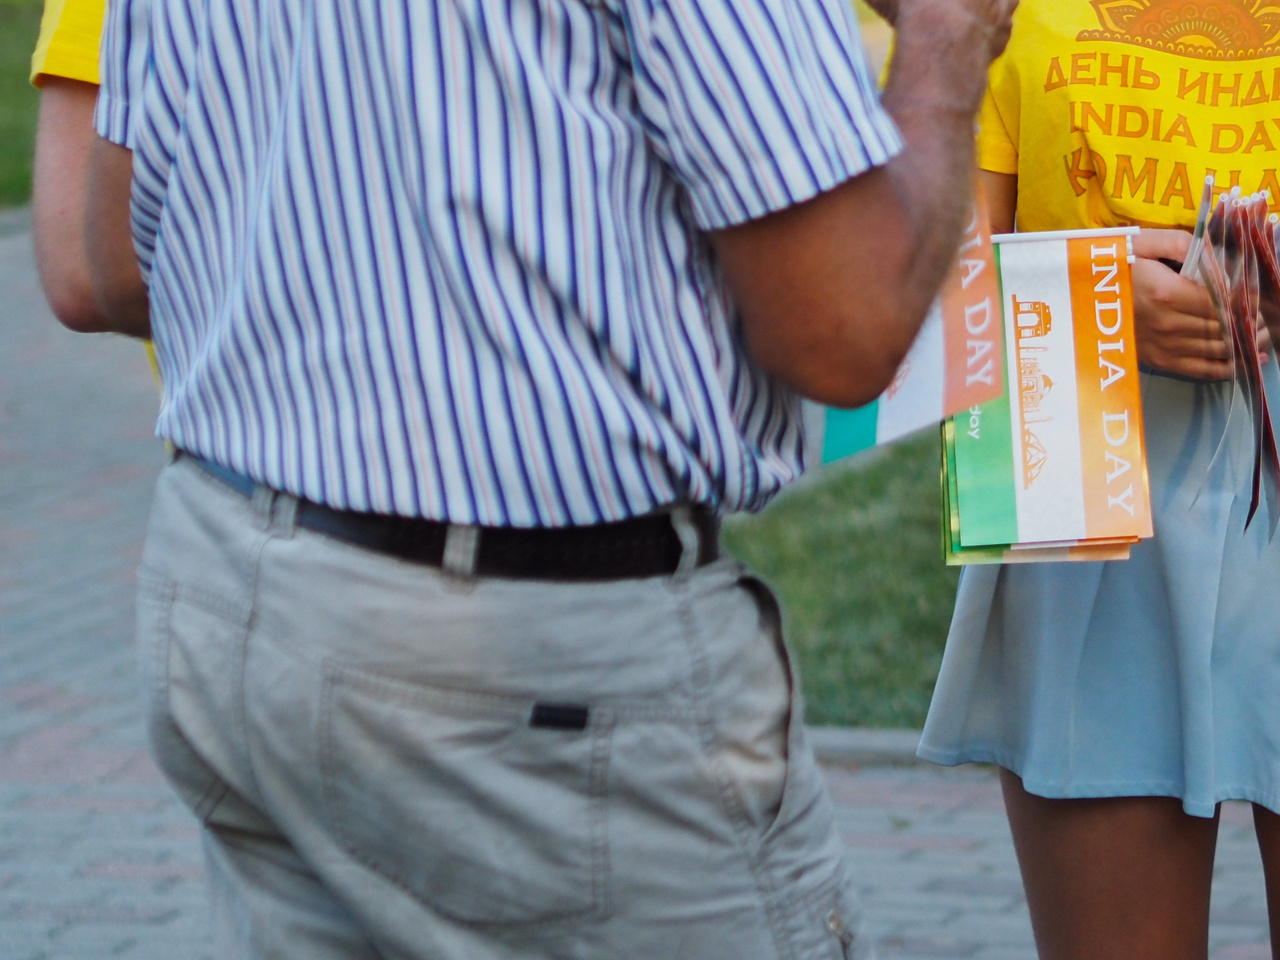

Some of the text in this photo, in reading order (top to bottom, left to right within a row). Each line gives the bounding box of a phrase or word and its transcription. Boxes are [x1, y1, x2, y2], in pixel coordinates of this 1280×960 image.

[1043, 51, 1161, 94] ДЕНЬ
[1069, 101, 1198, 149] INDIA
[964, 296, 995, 387] DAY
[1090, 242, 1135, 517] INDIA DAY
